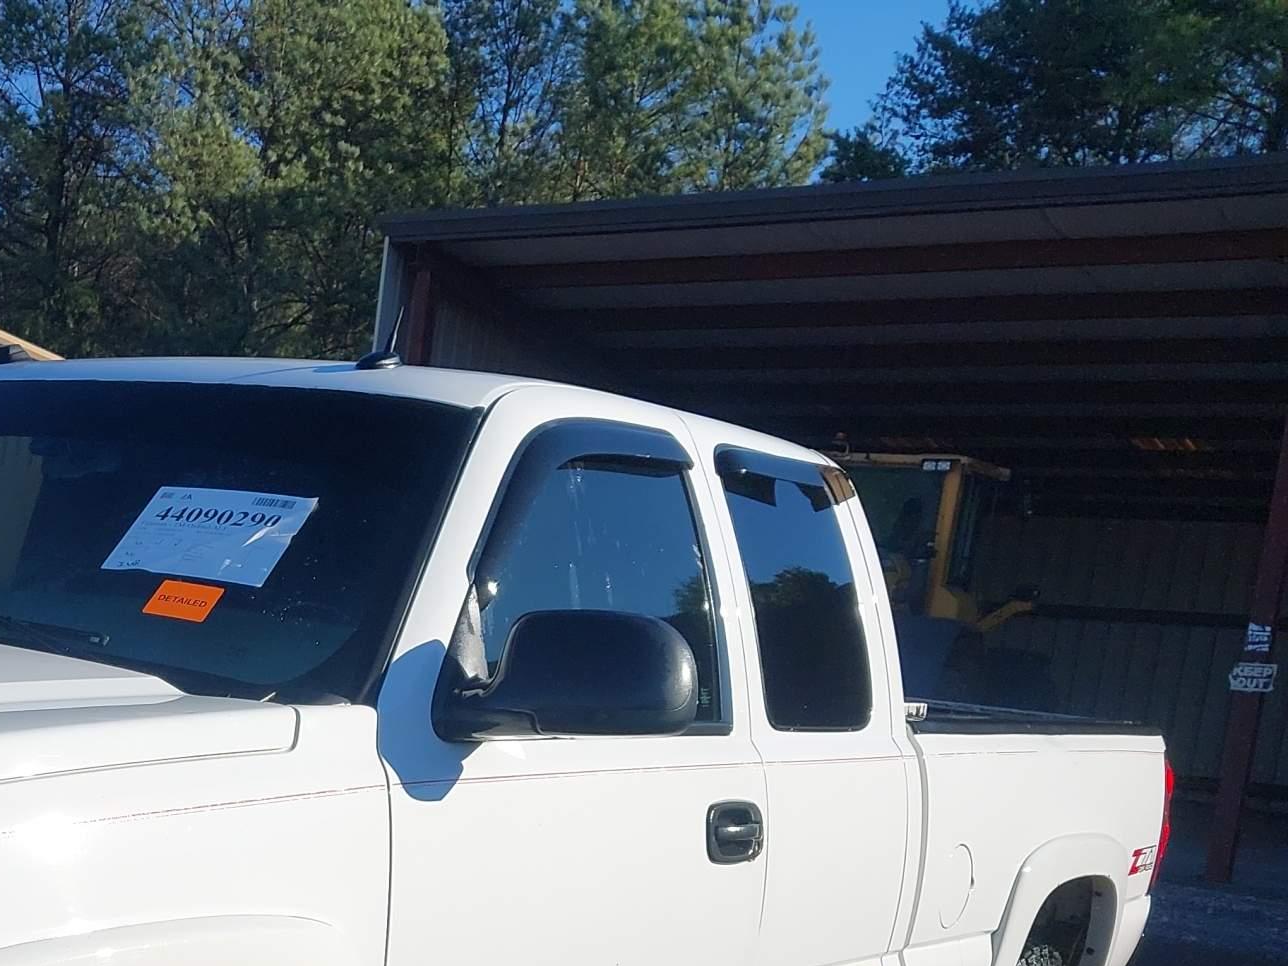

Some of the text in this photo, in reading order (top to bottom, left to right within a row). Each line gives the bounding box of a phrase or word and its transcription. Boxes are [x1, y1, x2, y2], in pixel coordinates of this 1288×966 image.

[154, 505, 283, 528] 44090290
[157, 593, 208, 609] DETAILED
[1232, 665, 1274, 677] KEEP
[1233, 677, 1272, 689] OUT
